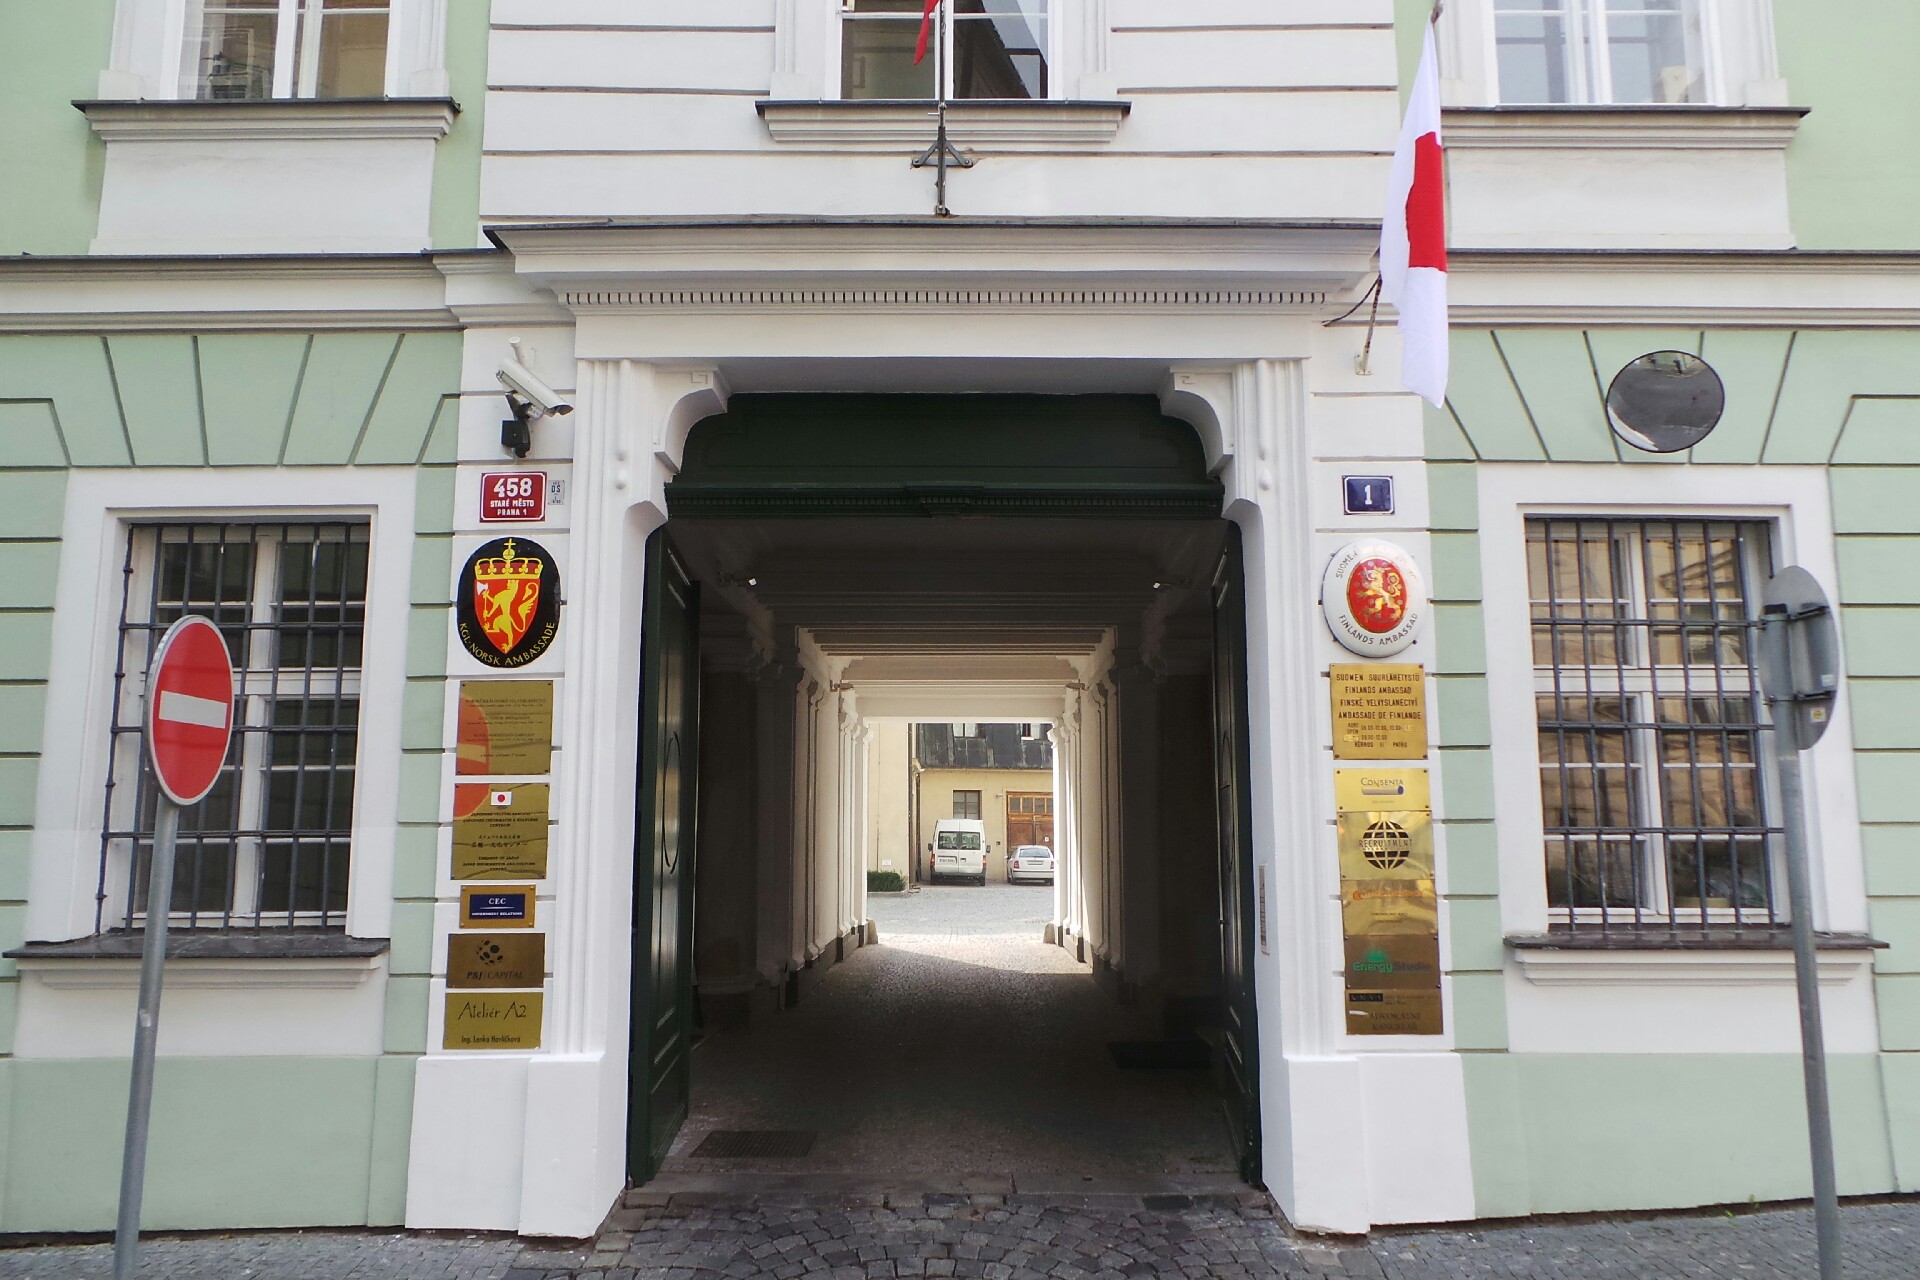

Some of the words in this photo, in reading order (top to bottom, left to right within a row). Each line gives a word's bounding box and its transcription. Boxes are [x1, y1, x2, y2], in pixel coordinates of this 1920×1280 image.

[493, 477, 532, 498] 458
[1364, 484, 1373, 505] 1
[490, 498, 510, 508] STARÉ
[512, 498, 535, 507] MĚSTO
[497, 508, 520, 516] PRAHA
[522, 508, 527, 516] 1
[1338, 613, 1374, 645] FINLANDS
[1379, 612, 1419, 646] AMBASSAD
[469, 642, 501, 666] NORSK
[504, 621, 555, 666] AMBASSADE
[1336, 673, 1364, 681] SUOMEN
[1368, 673, 1420, 682] SUURLÄHETYSTÖ
[1345, 686, 1376, 694] FINLANDS
[1379, 686, 1412, 694] AMBASSAD
[1340, 698, 1363, 707] FINSKÉ
[1366, 697, 1418, 707] VELVYSLANECTVÍ
[1338, 711, 1376, 720] AMBASSADE
[1378, 711, 1386, 719] DE
[1389, 711, 1421, 719] FINLANDE
[1359, 838, 1413, 848] RECRUITMENT
[488, 897, 507, 905] CEC
[457, 1001, 500, 1020] Ateliér
[503, 1000, 527, 1020] A2
